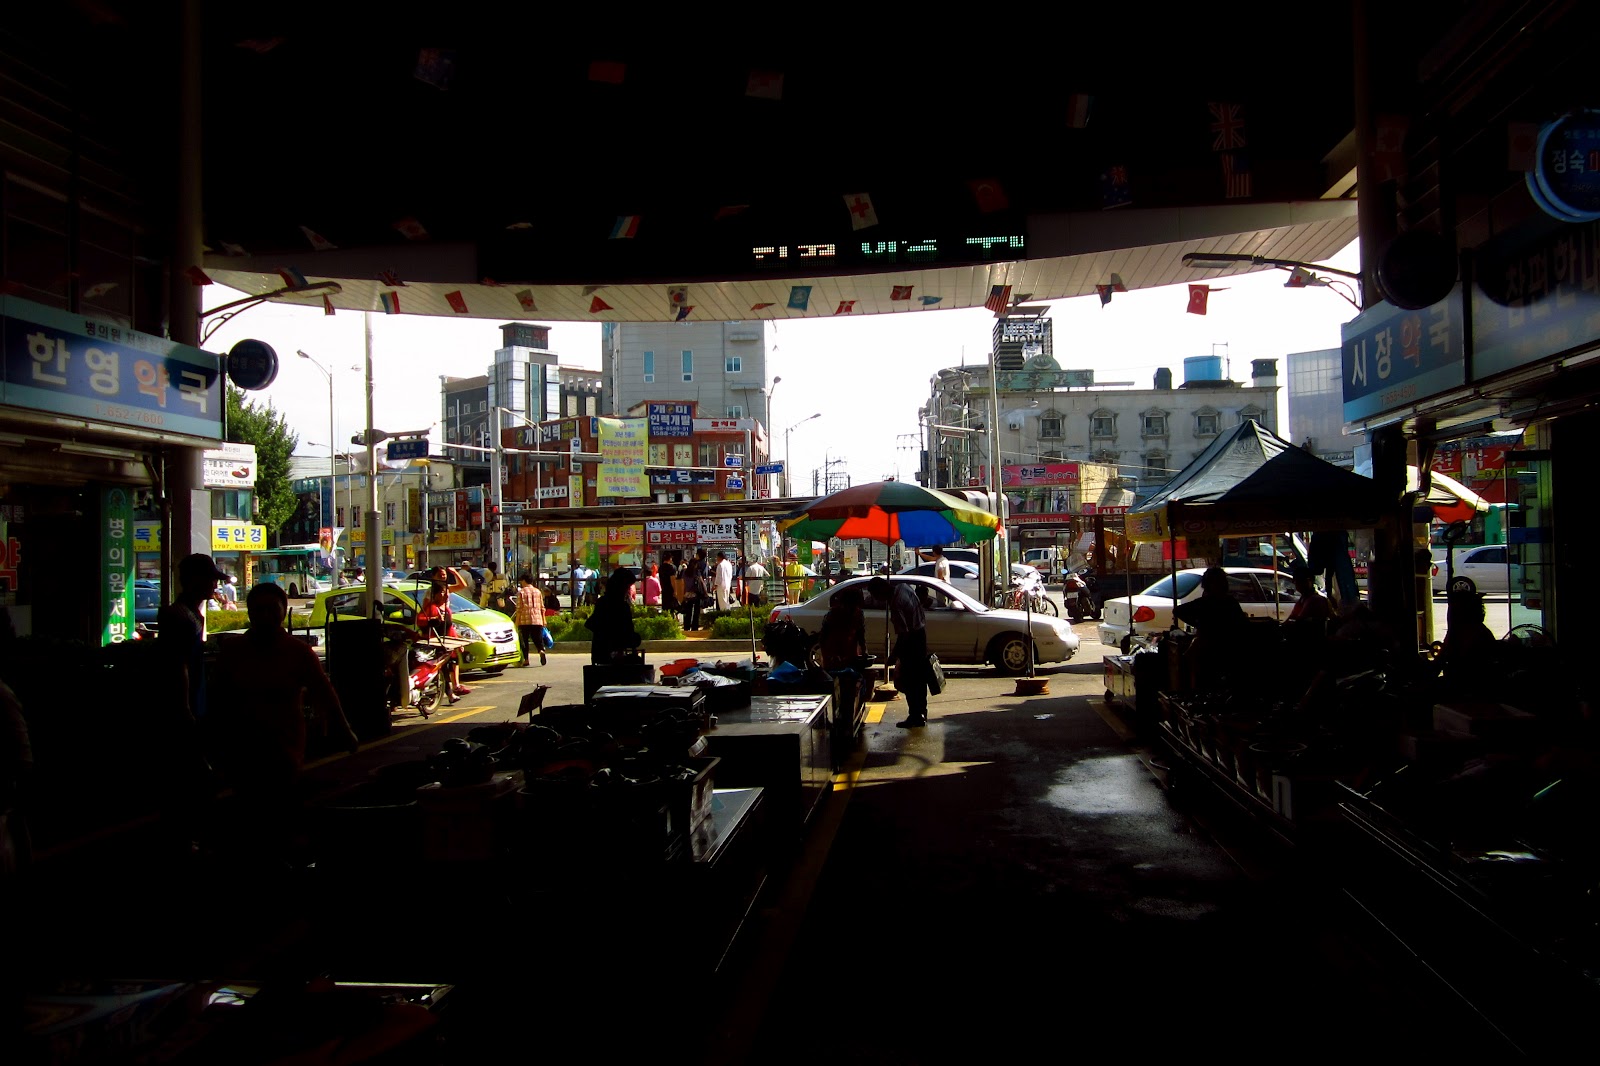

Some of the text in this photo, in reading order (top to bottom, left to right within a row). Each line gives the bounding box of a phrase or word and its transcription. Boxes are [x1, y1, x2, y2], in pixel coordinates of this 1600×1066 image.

[1351, 301, 1450, 388] 시장약국
[26, 331, 208, 414] 한영약국
[650, 415, 691, 426] 인력개발
[217, 528, 262, 542] 독안경
